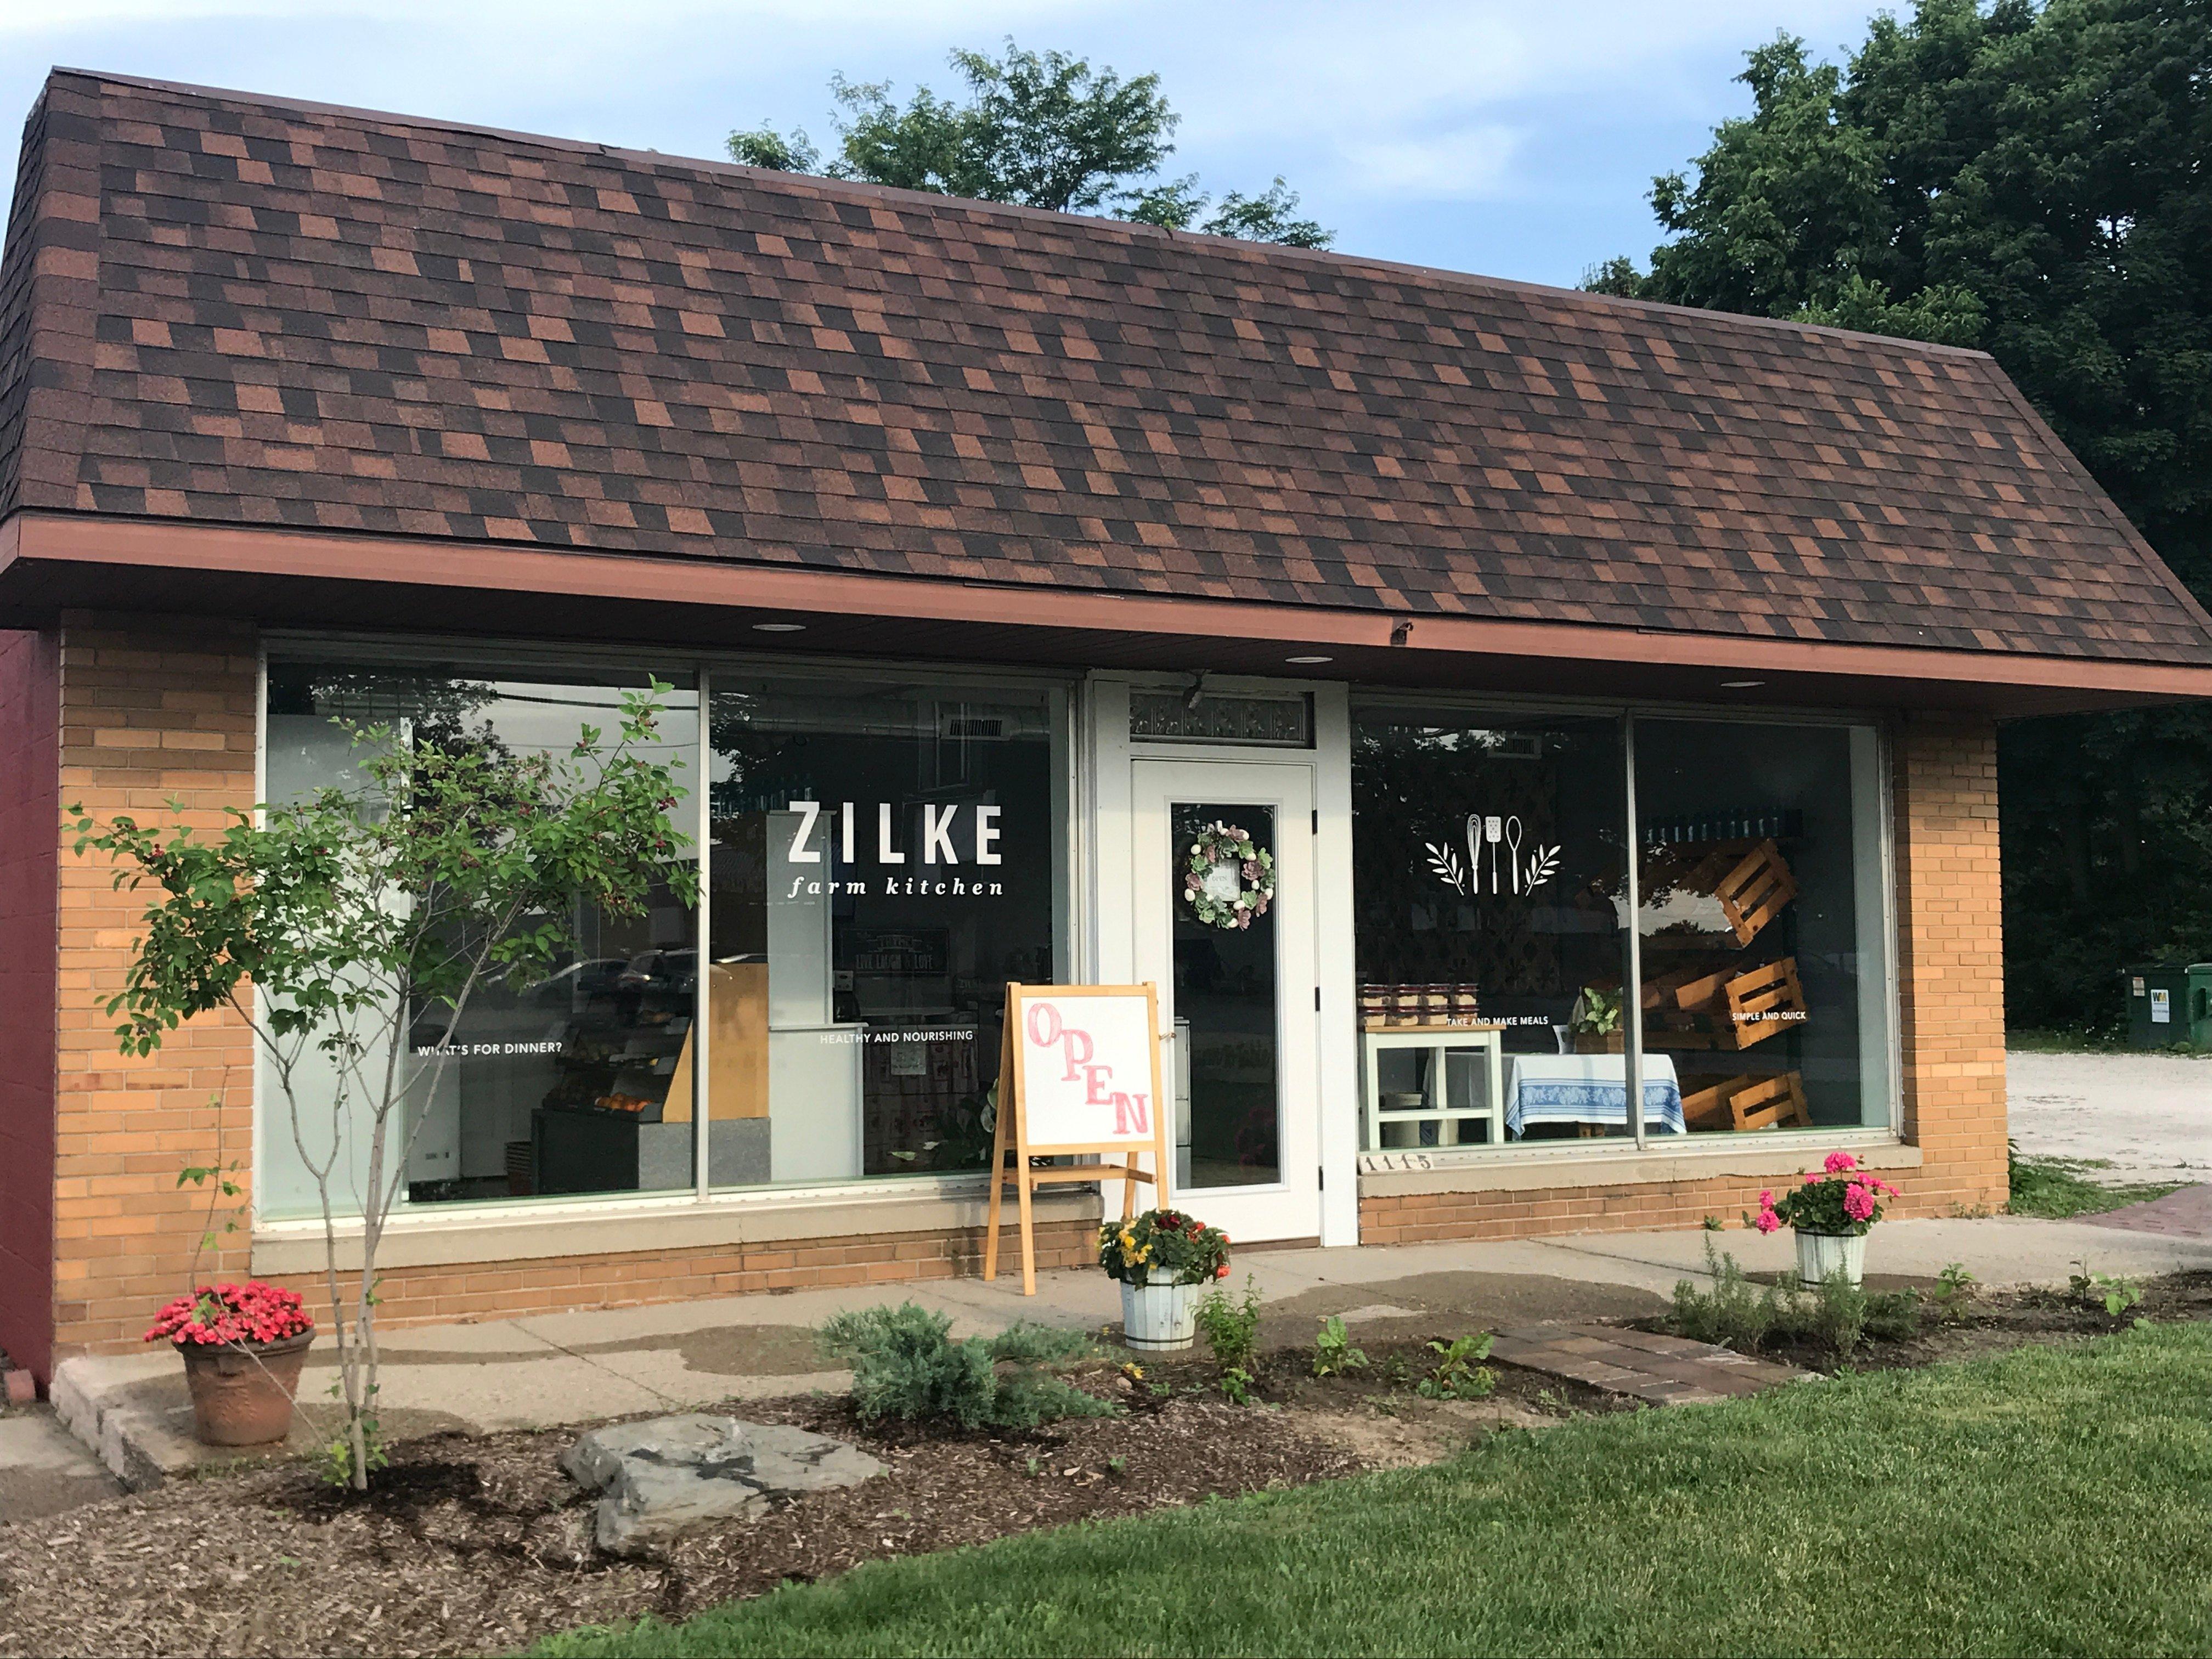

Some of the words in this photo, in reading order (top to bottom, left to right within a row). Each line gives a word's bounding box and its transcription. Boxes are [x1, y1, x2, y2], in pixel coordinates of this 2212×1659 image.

[788, 801, 1002, 865] ZILKE
[787, 876, 866, 899] farm
[885, 877, 1003, 895] kitchen
[856, 954, 873, 969] LIVE
[914, 954, 933, 969] LOVE
[1447, 1017, 1469, 1027] TAKE
[1471, 1017, 1491, 1026] AND
[1493, 1016, 1518, 1026] MAKE
[1520, 1016, 1548, 1025] MEALS
[1732, 1012, 1760, 1021] SIMPLE
[1762, 1011, 1780, 1020] AND
[1781, 1011, 1807, 1020] QUICK
[820, 1034, 871, 1043] HEALTHY
[874, 1032, 900, 1043] AND
[903, 1030, 973, 1042] NOURISHING
[473, 1043, 500, 1056] FOR
[504, 1042, 562, 1054] DINNER?
[1028, 1003, 1149, 1135] OPEN
[1365, 1154, 1431, 1171] 1115
